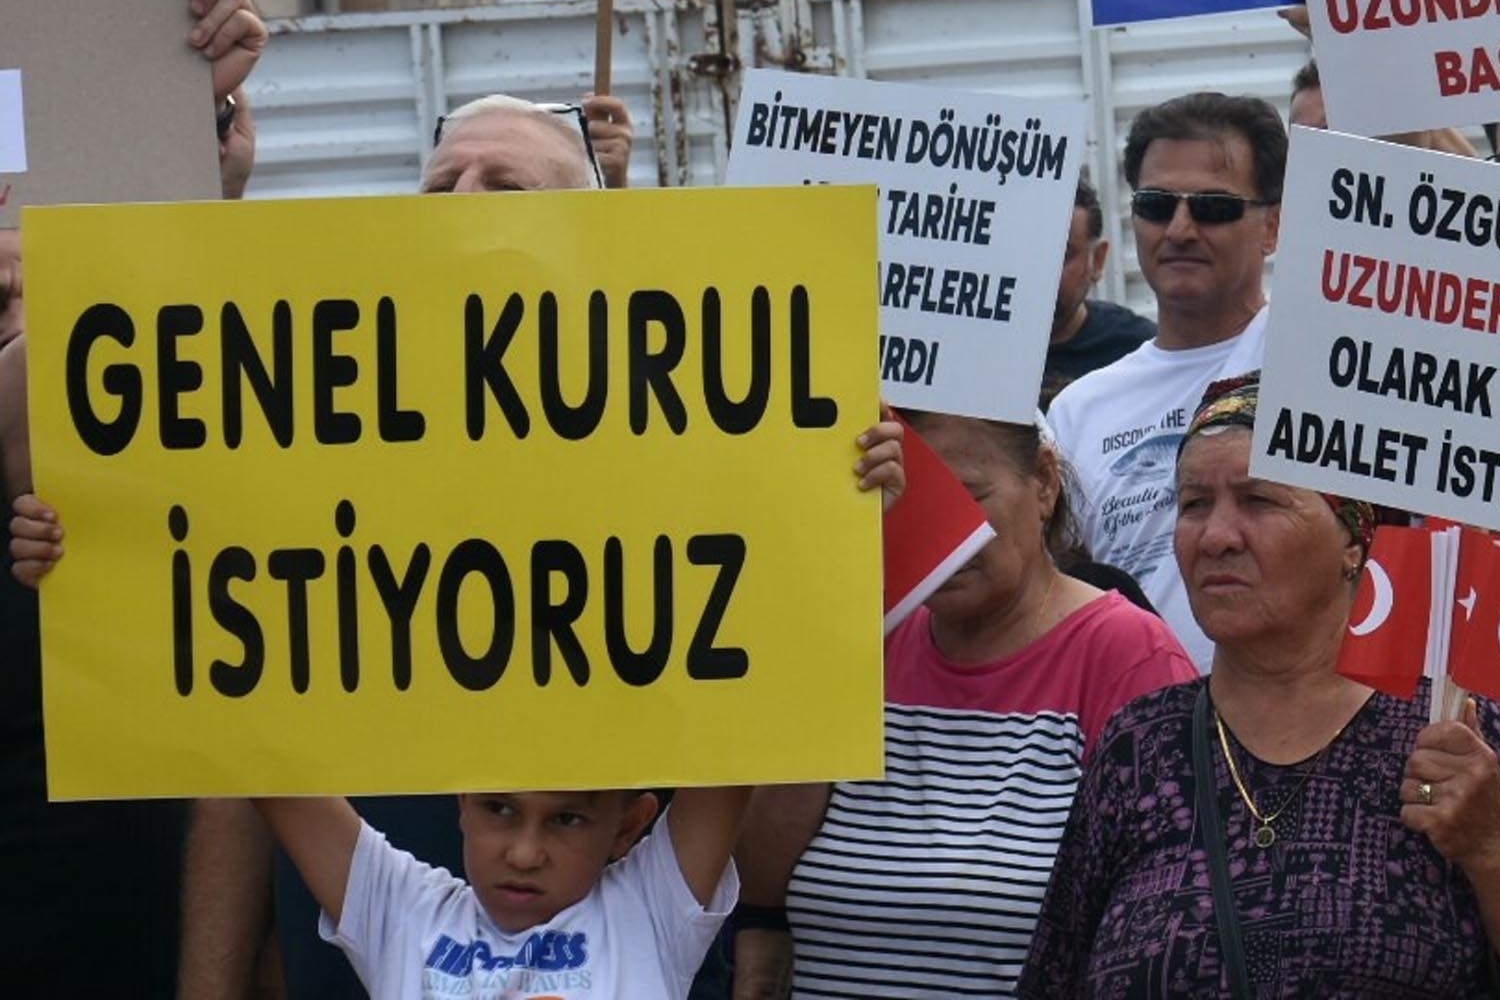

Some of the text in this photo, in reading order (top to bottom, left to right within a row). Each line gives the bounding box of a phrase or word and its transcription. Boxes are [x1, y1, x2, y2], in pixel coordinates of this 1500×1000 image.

[747, 91, 1067, 185] BİTMEYEN DÖNÜŞÜM
[888, 183, 995, 245] TARİHE
[1329, 169, 1393, 228] SN.
[880, 263, 1016, 321] RFLERLE
[66, 285, 837, 456] GENEL KURUL
[1330, 337, 1497, 418] OLARAK
[1267, 408, 1428, 485] ADALET
[169, 500, 748, 698] İSTİYORUZ
